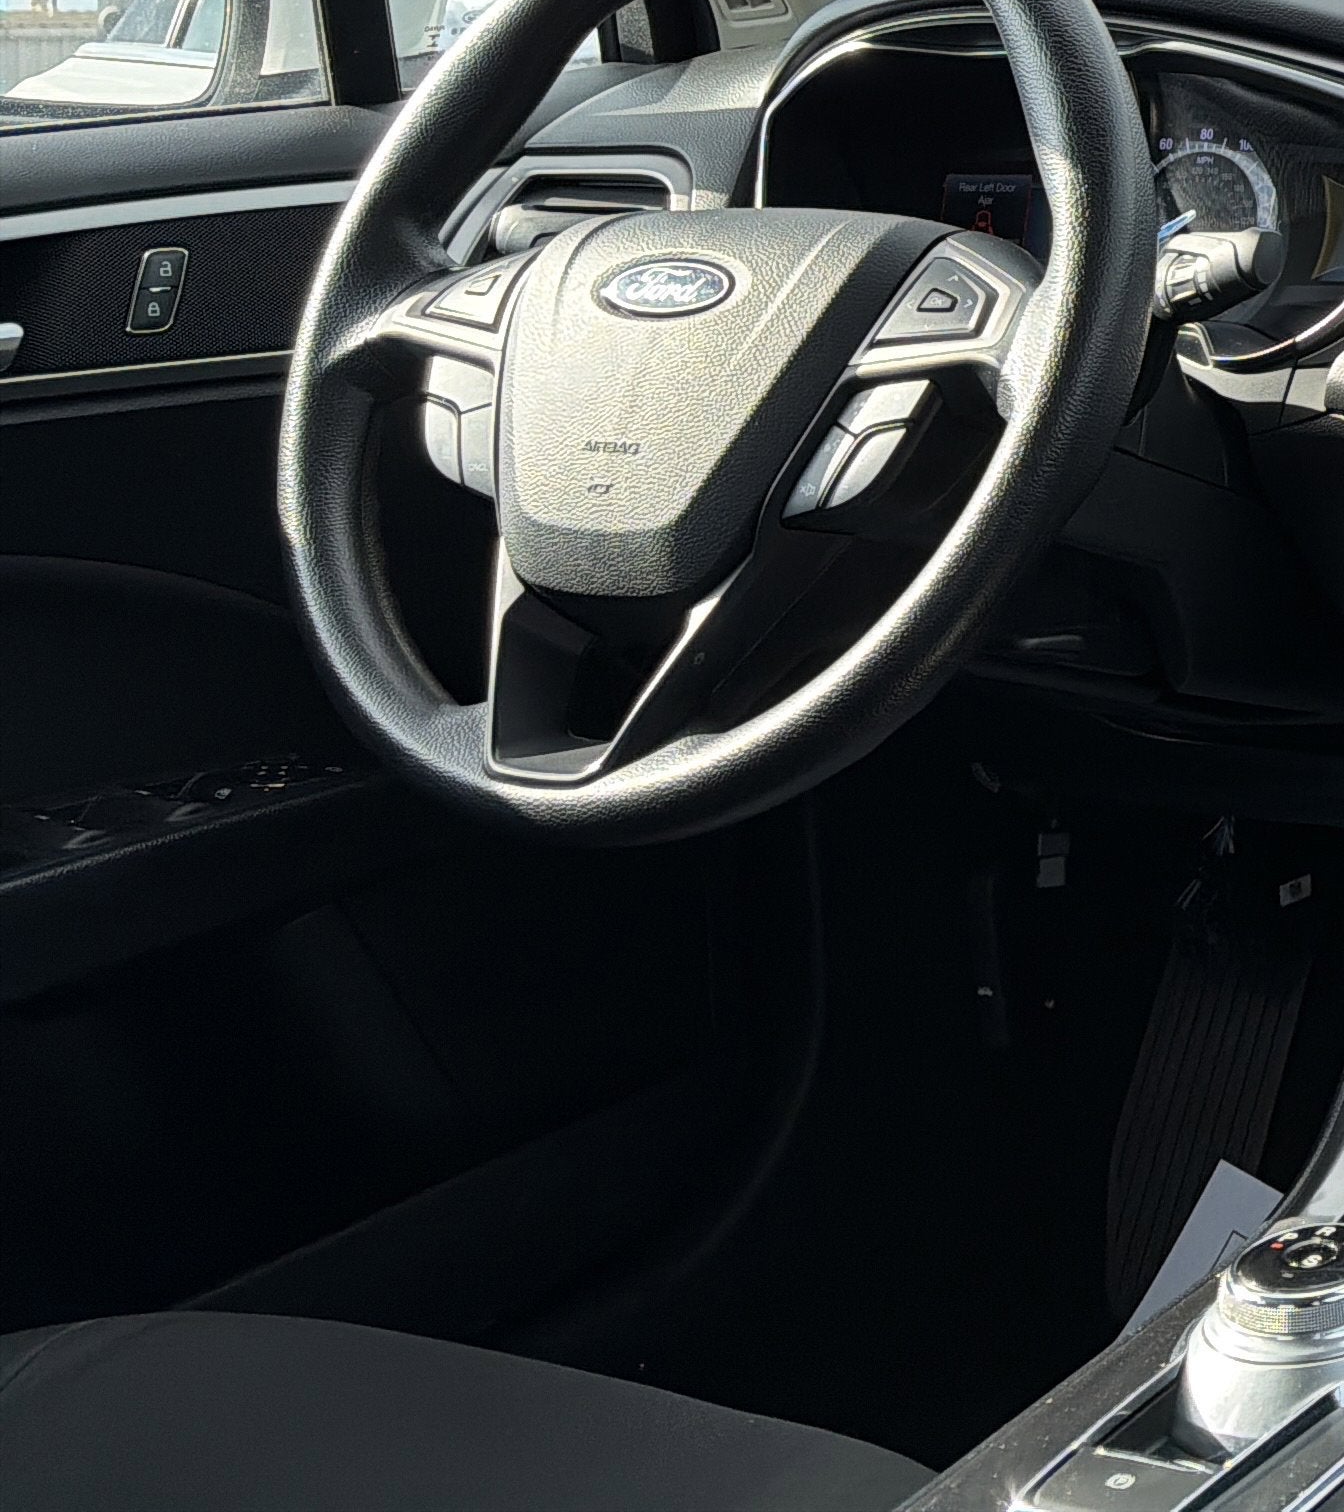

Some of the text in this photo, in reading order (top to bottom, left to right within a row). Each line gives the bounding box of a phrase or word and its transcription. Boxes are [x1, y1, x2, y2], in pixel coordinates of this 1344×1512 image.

[1200, 128, 1213, 140] 80
[1159, 139, 1173, 151] 60
[1197, 155, 1214, 165] MPH
[959, 183, 1016, 192] Rear Left Door
[978, 196, 994, 207] Ajar
[625, 266, 706, 304] Ford
[1277, 1232, 1298, 1242] P
[1315, 1226, 1336, 1237] R
[1302, 1254, 1323, 1269] S
